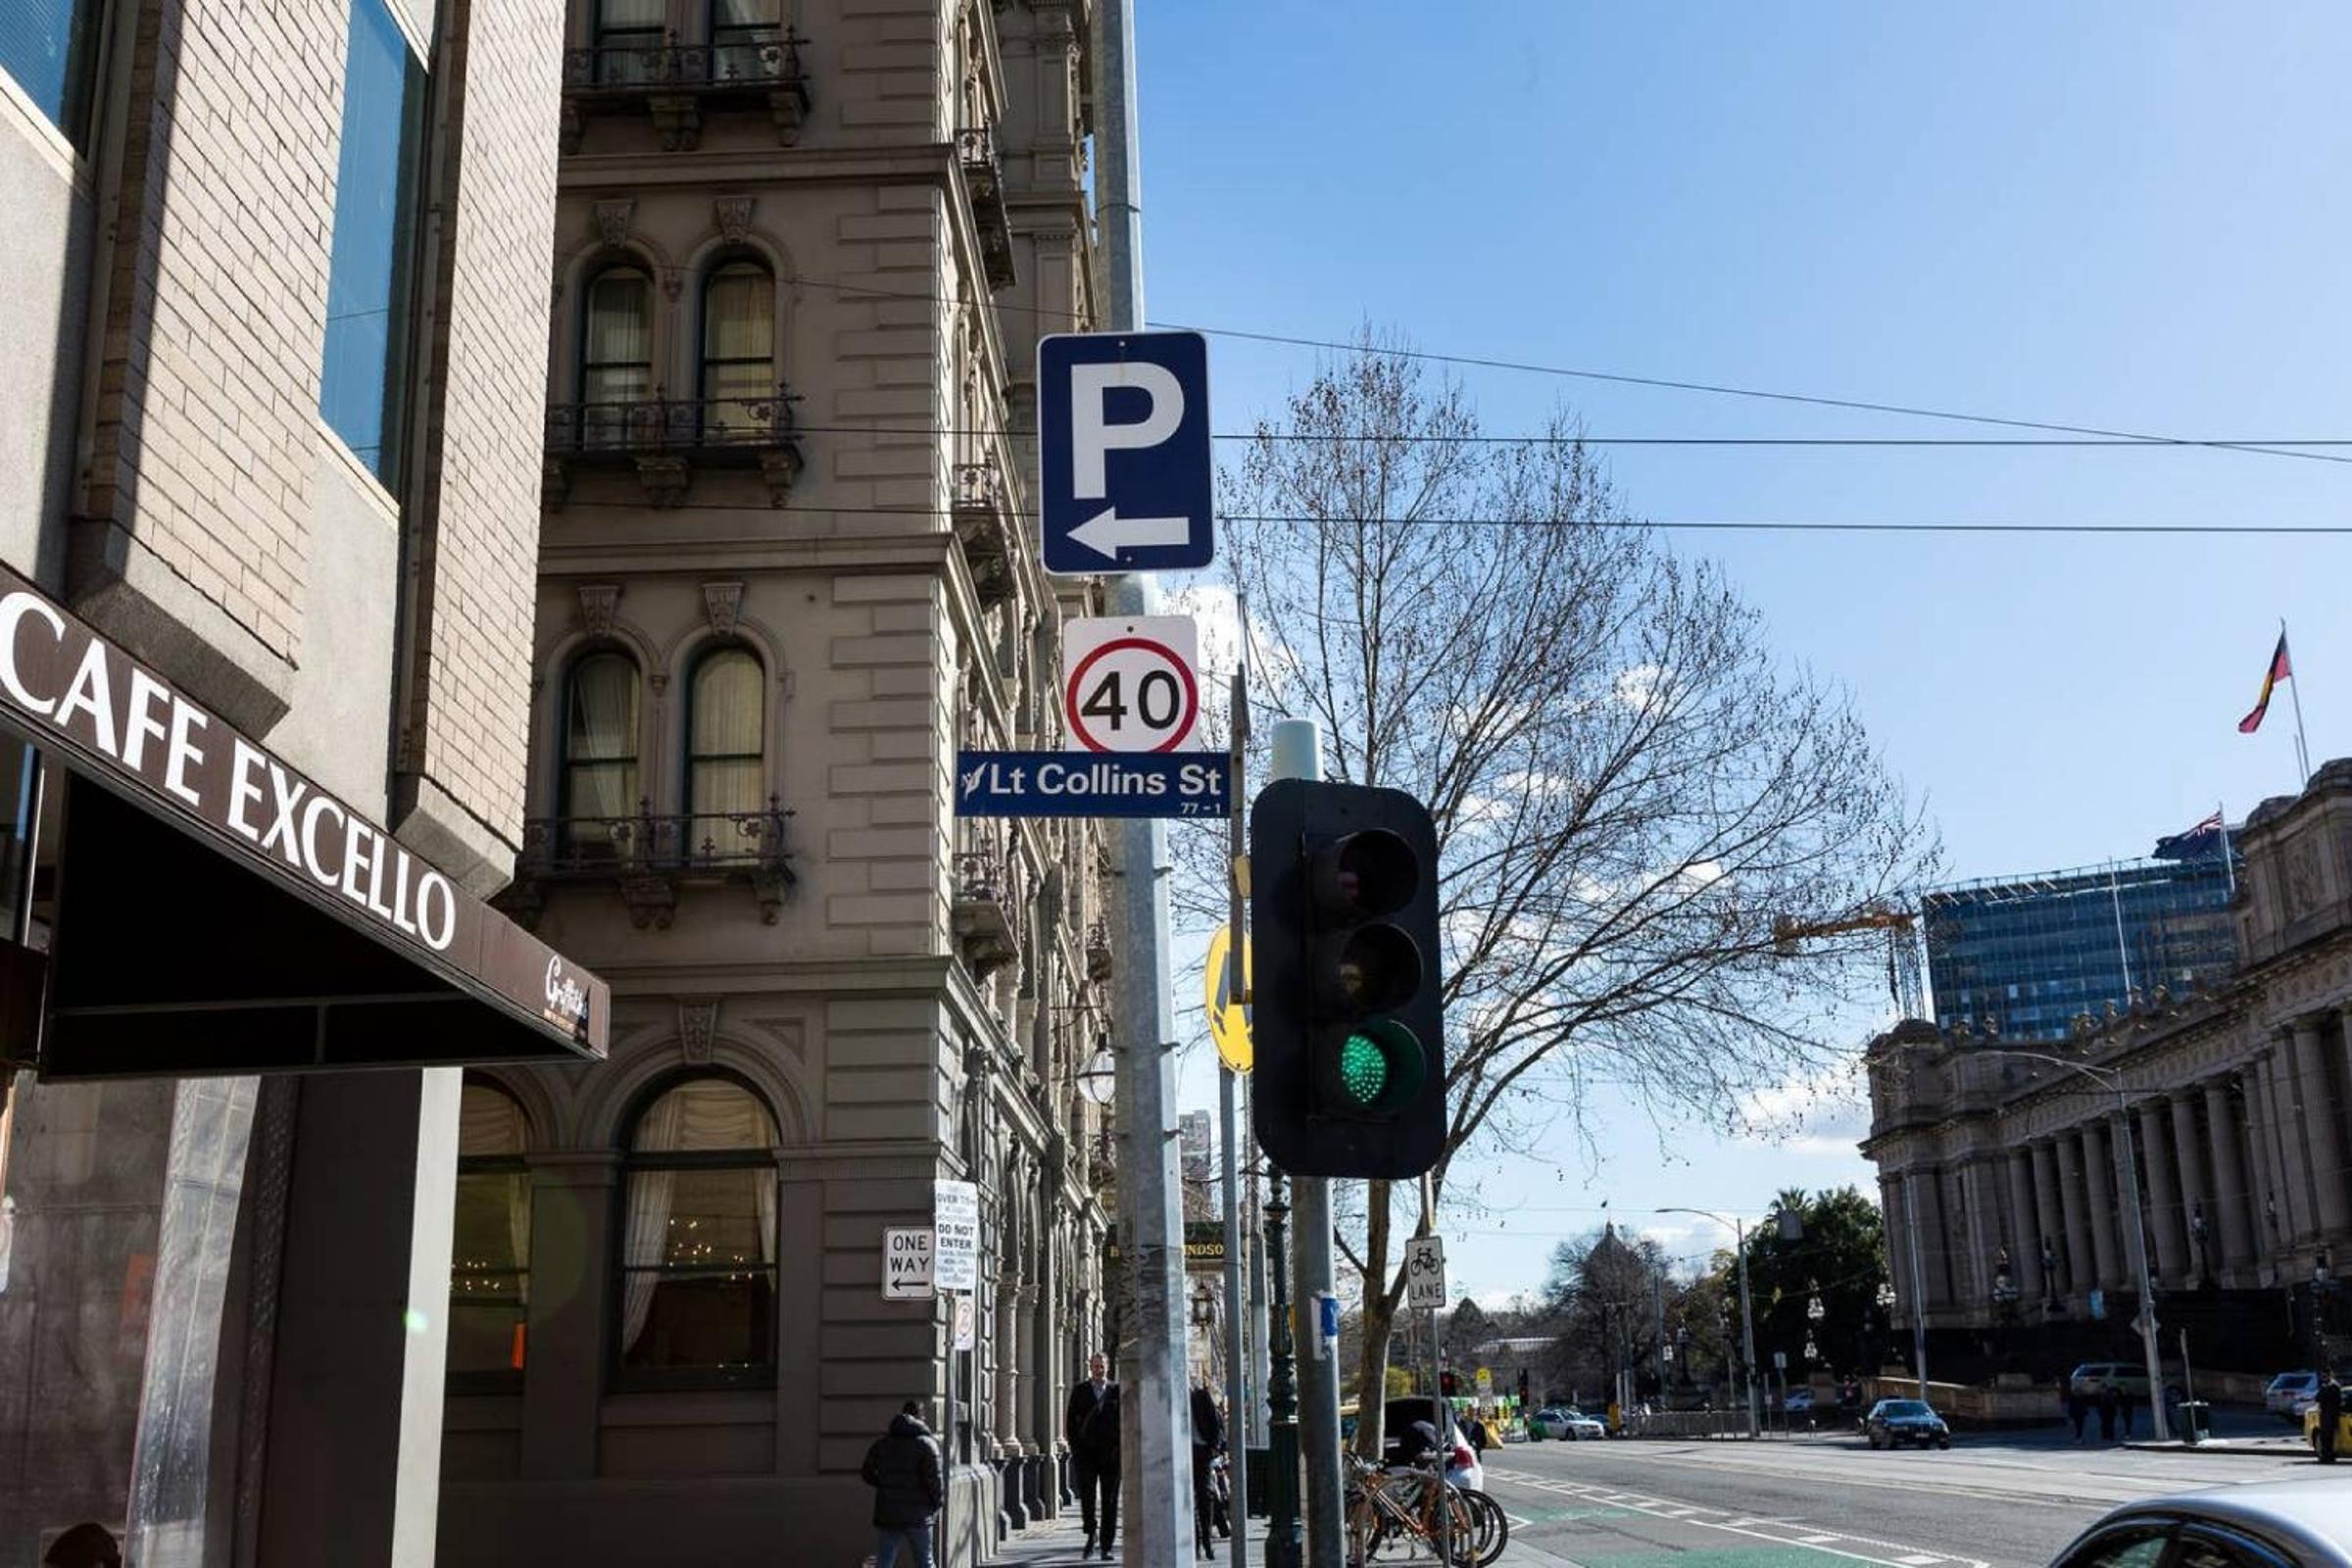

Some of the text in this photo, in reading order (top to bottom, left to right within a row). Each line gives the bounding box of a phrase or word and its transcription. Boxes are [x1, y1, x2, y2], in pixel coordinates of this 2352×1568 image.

[1071, 362, 1185, 500] P
[1080, 669, 1180, 731] 40
[0, 591, 457, 951] CAFE EXCELLO
[989, 763, 1221, 796] Lt Collins St
[938, 1224, 974, 1236] DO NOT
[893, 1235, 928, 1251] ONE
[940, 1238, 972, 1250] ENTER
[1183, 1244, 1224, 1255] INDSO
[890, 1256, 930, 1273] WAY
[1411, 1282, 1441, 1300] LANE
